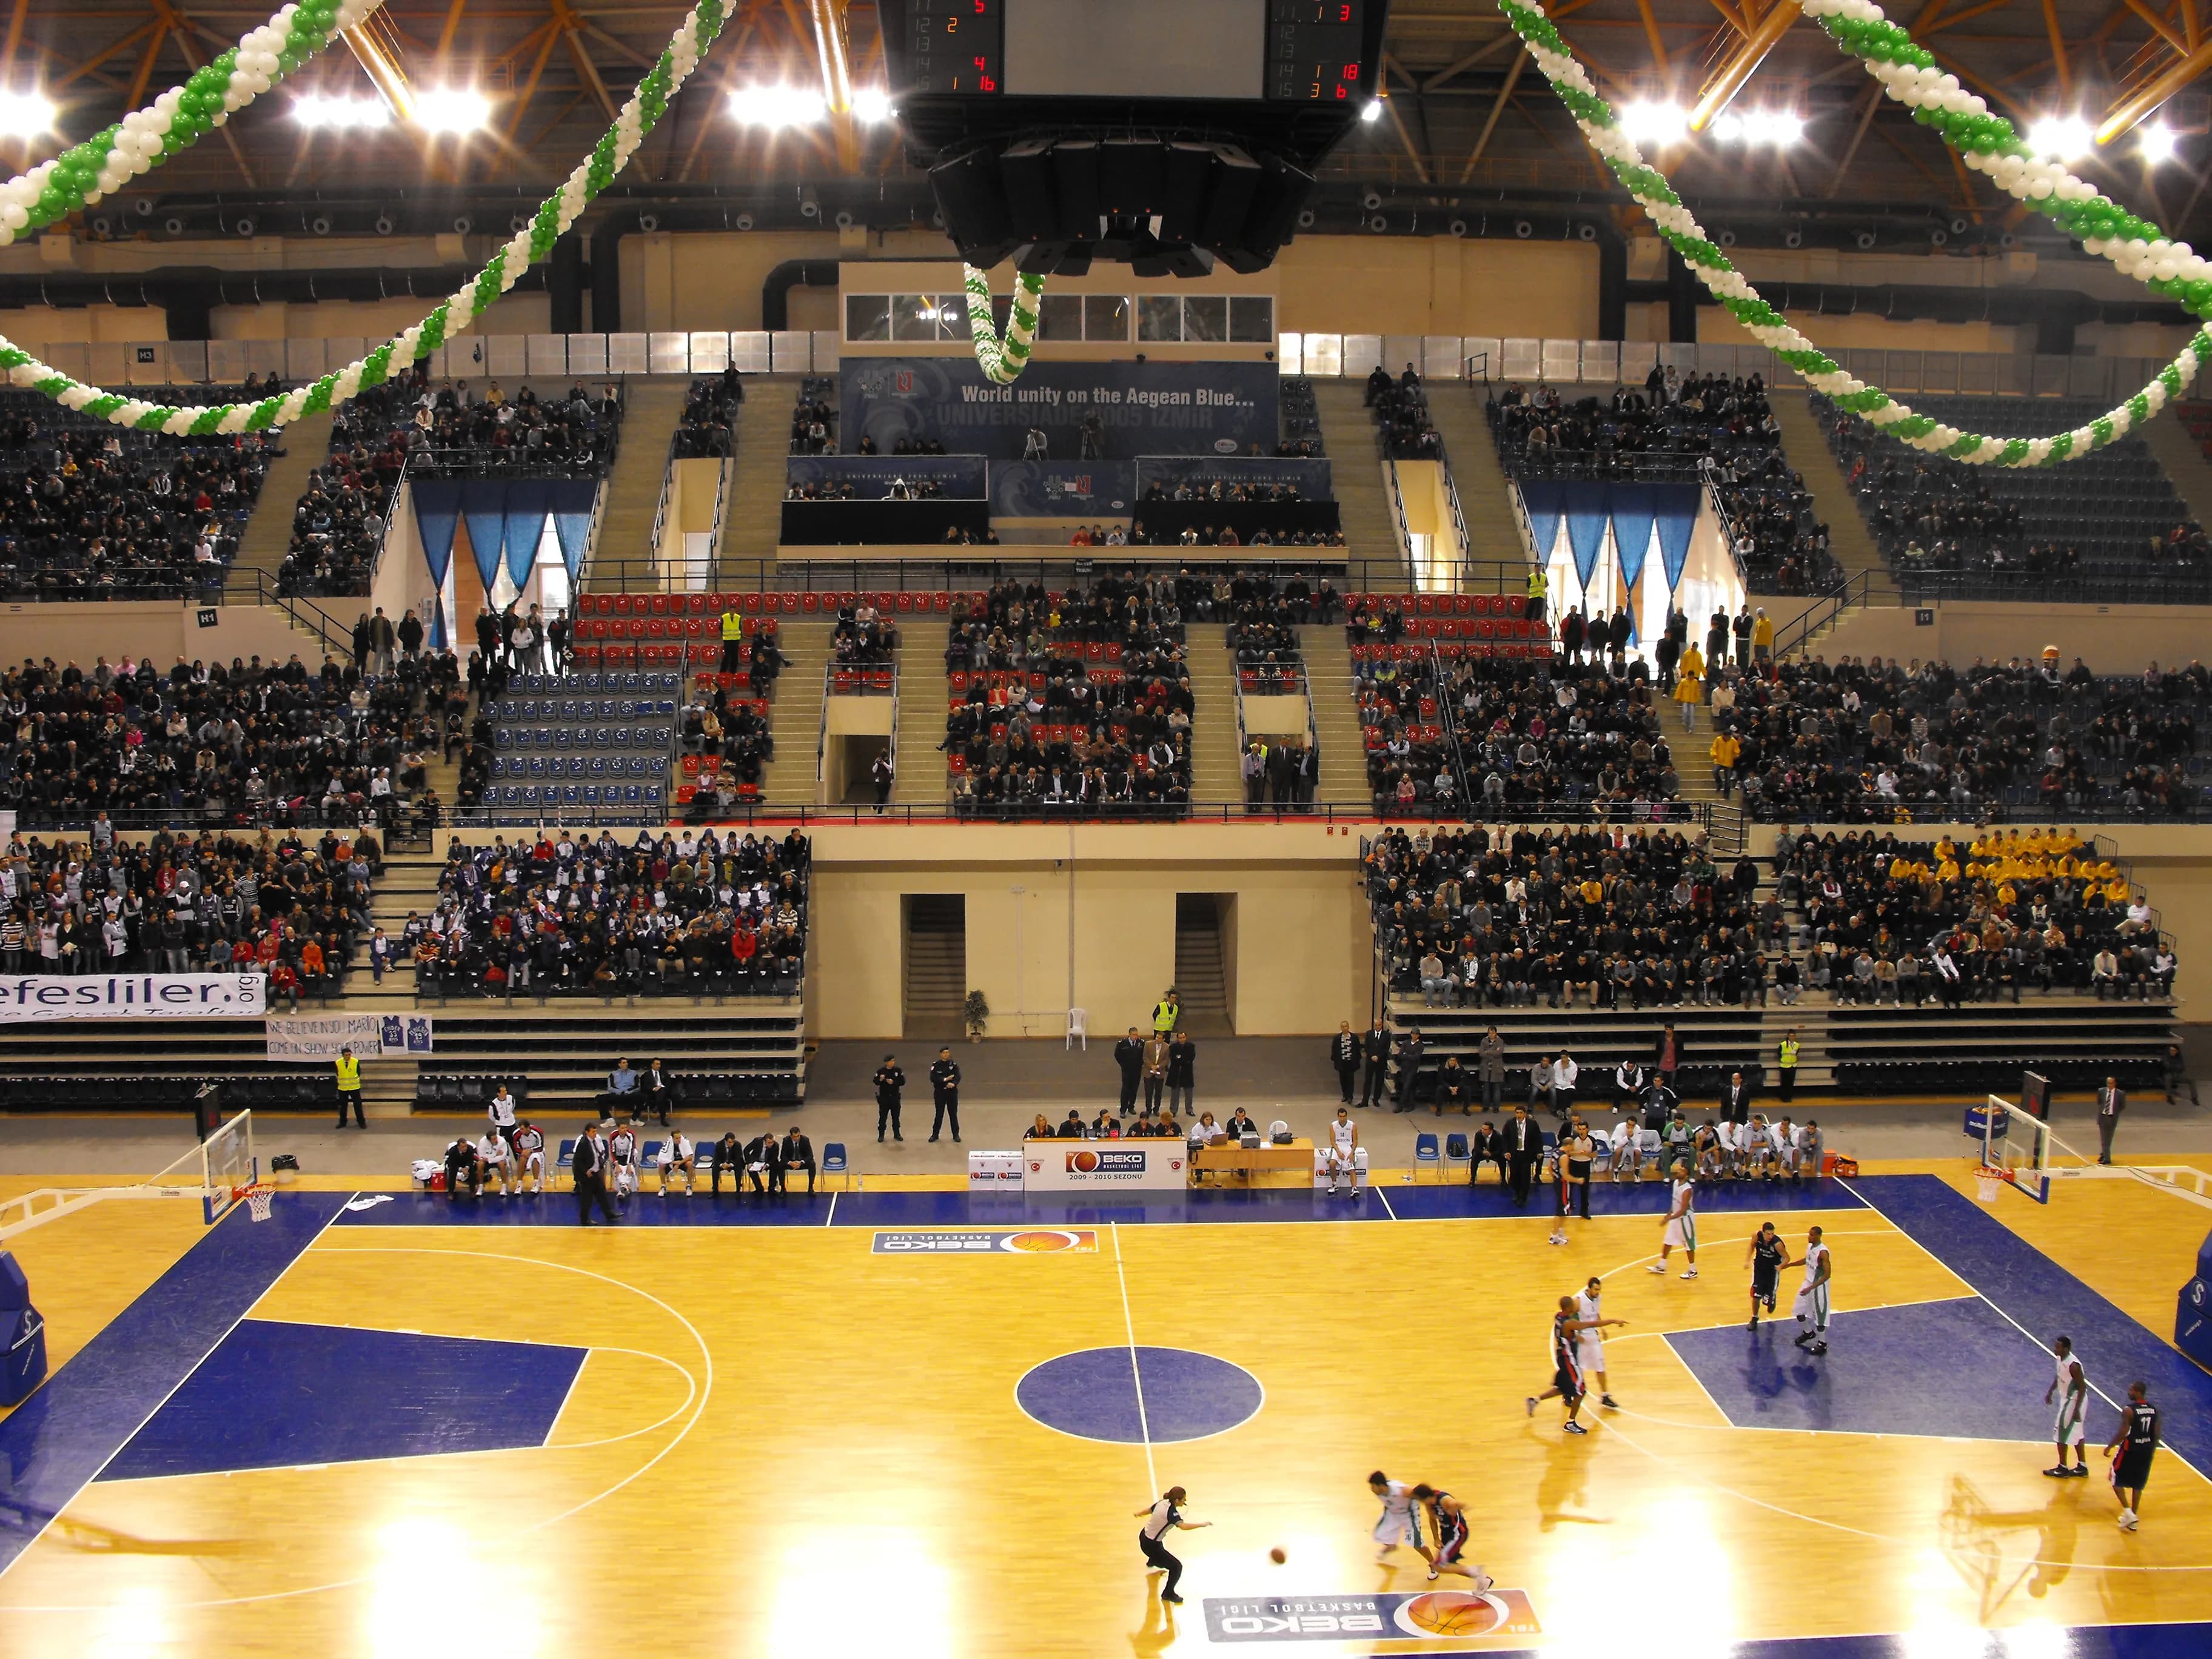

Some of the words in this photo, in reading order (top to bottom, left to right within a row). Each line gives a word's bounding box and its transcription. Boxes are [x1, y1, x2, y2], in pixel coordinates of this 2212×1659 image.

[1339, 5, 1350, 21] 3
[948, 18, 957, 32] 2
[974, 56, 985, 71] 4
[1343, 64, 1358, 79] 18
[1310, 82, 1320, 98] 3
[962, 386, 1012, 403] World
[1018, 387, 1061, 407] unity
[1067, 390, 1087, 403] on
[1093, 387, 1121, 404] the
[1126, 388, 1191, 407] Aegean
[1196, 389, 1254, 407] Blue...
[936, 404, 1083, 426] UNIVERSIADE
[1093, 406, 1142, 426] 005
[201, 613, 214, 623] H1
[268, 1021, 283, 1033] WE
[269, 1042, 289, 1054] COME
[304, 1042, 328, 1054] SHOW
[354, 1041, 378, 1053] POWER
[1102, 1155, 1142, 1163] BEKO
[883, 1241, 991, 1250] BEKO
[1270, 1602, 1376, 1612] BASKETBOL
[1222, 1614, 1383, 1634] BEKO
